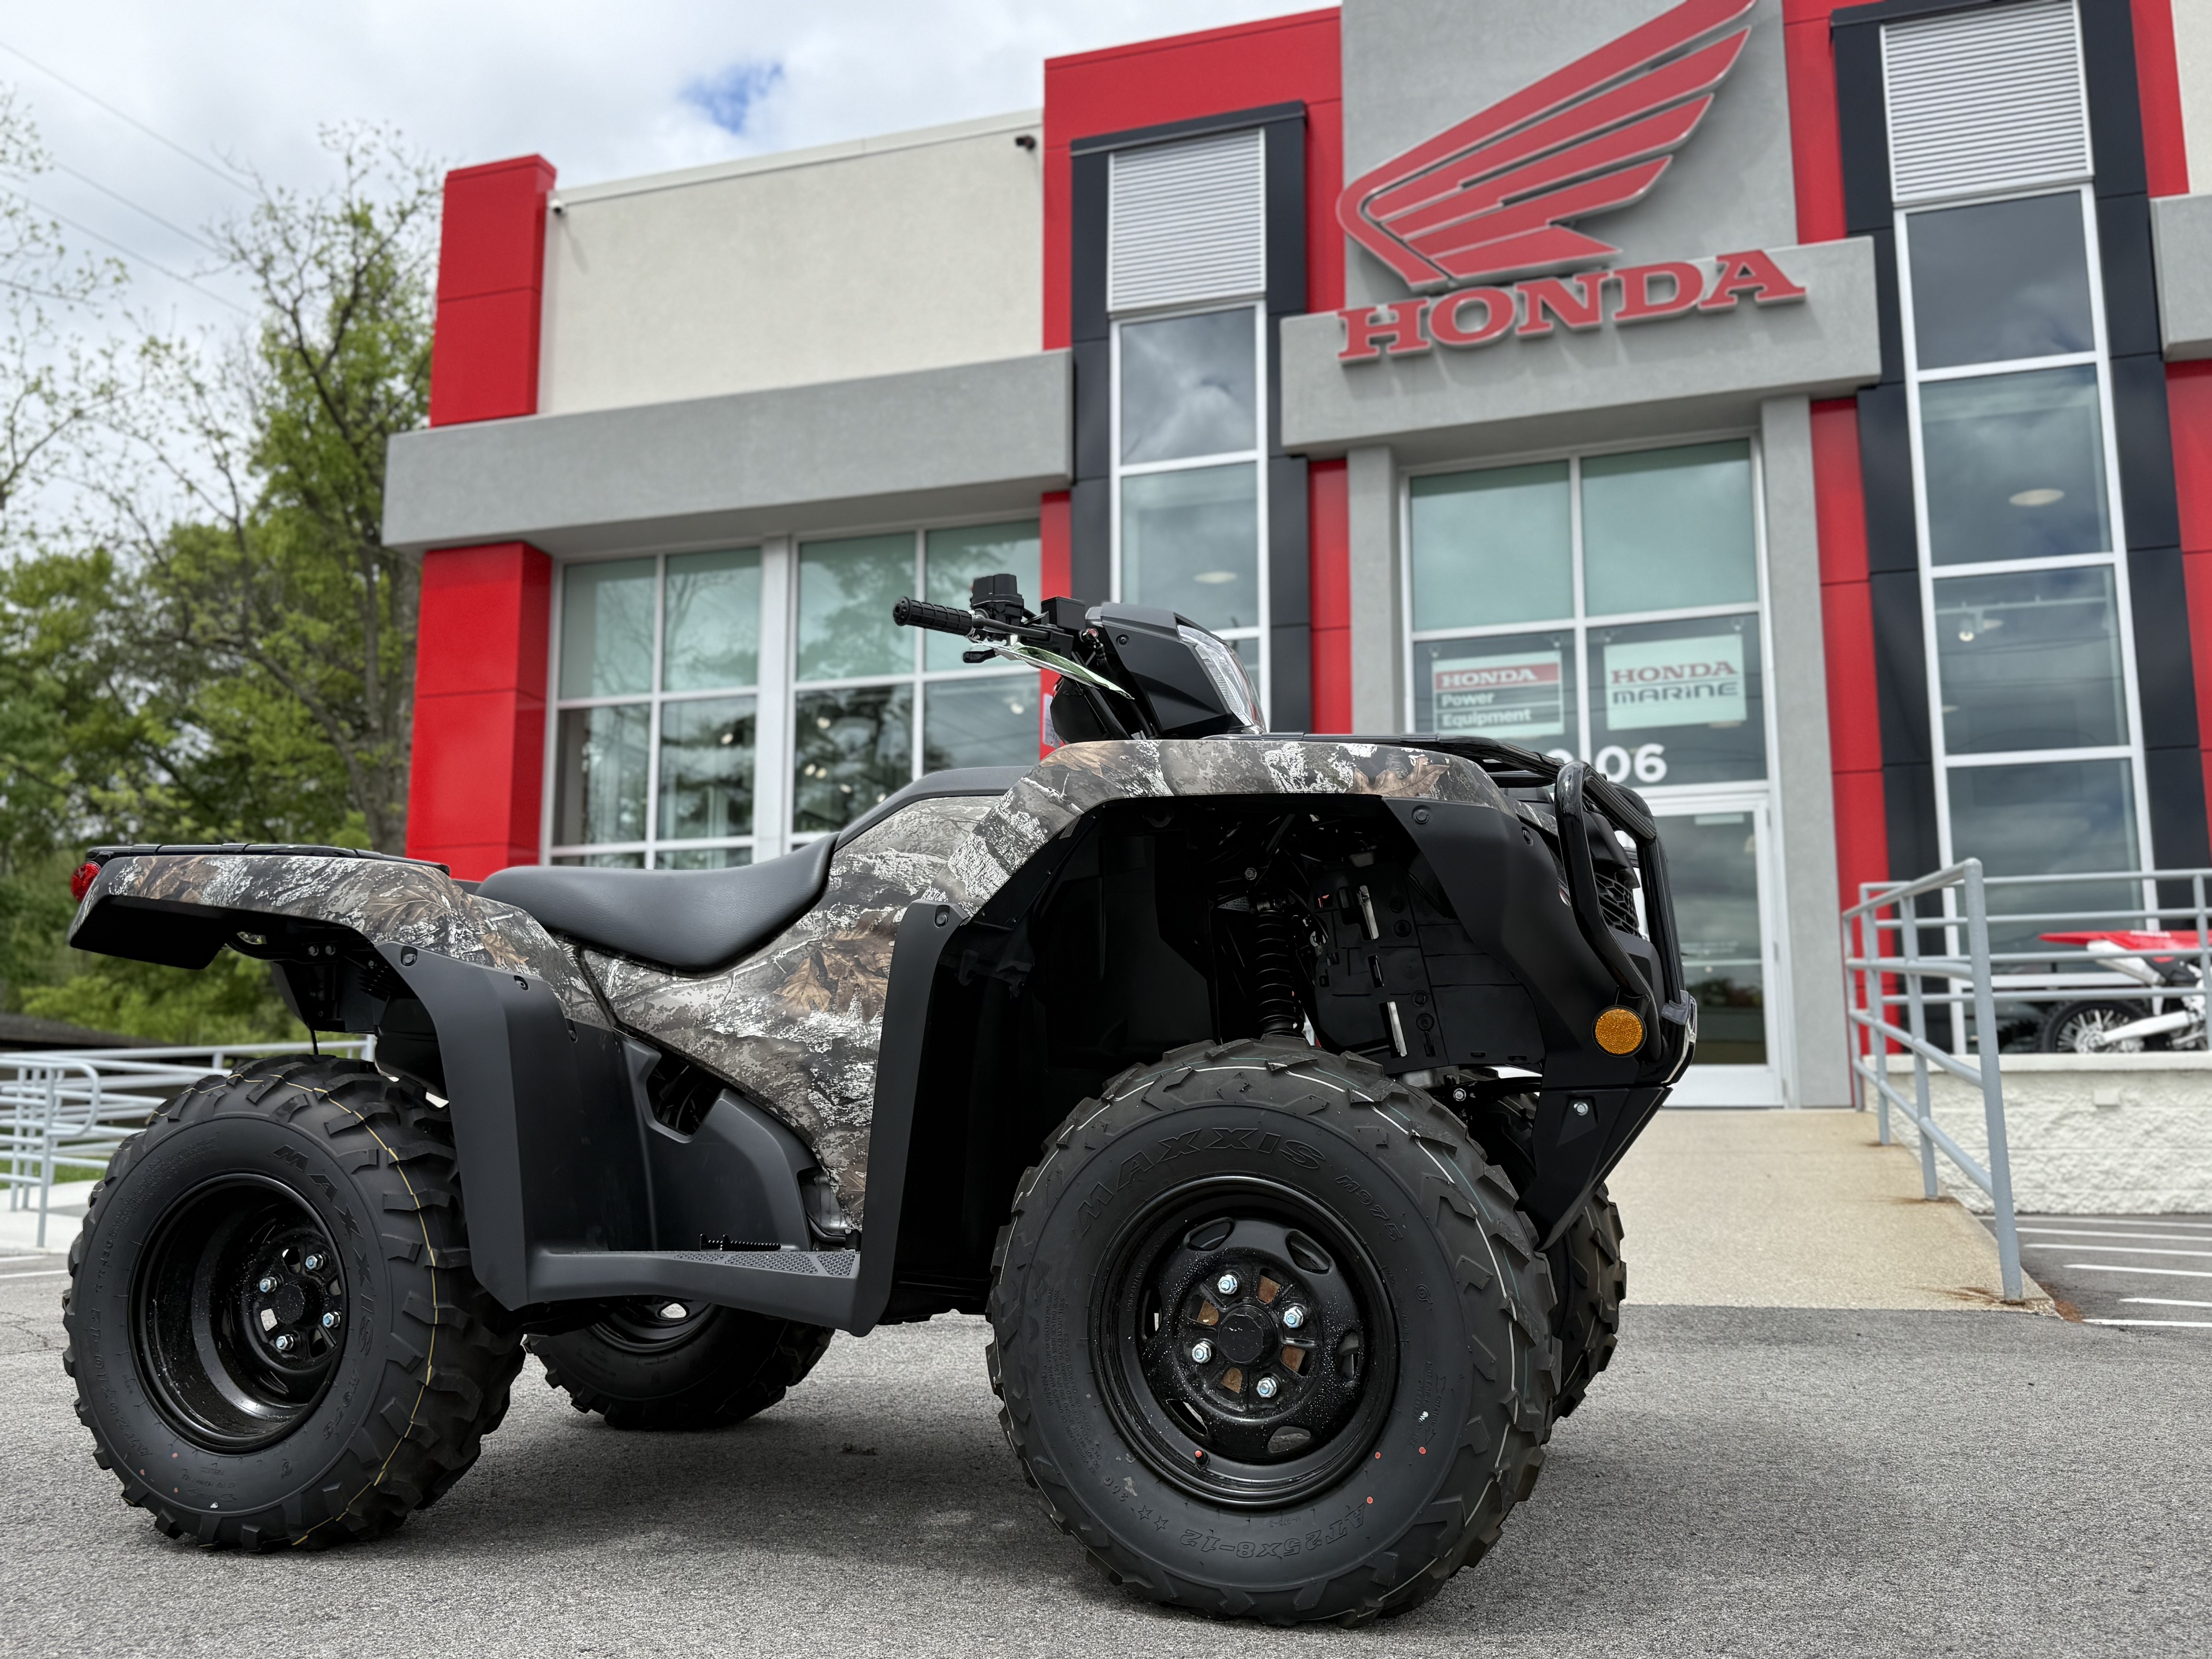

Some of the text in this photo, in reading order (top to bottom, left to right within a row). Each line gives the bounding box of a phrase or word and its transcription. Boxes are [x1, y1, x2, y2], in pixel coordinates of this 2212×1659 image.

[1337, 249, 1807, 363] HONDA
[1442, 668, 1537, 687] HONDA
[1612, 660, 1737, 685] HONDA
[1442, 692, 1494, 707] Power
[1442, 708, 1532, 728] Equipment
[1075, 1127, 1403, 1241] MAXXIS M975
[272, 1144, 374, 1357] MAXXIS
